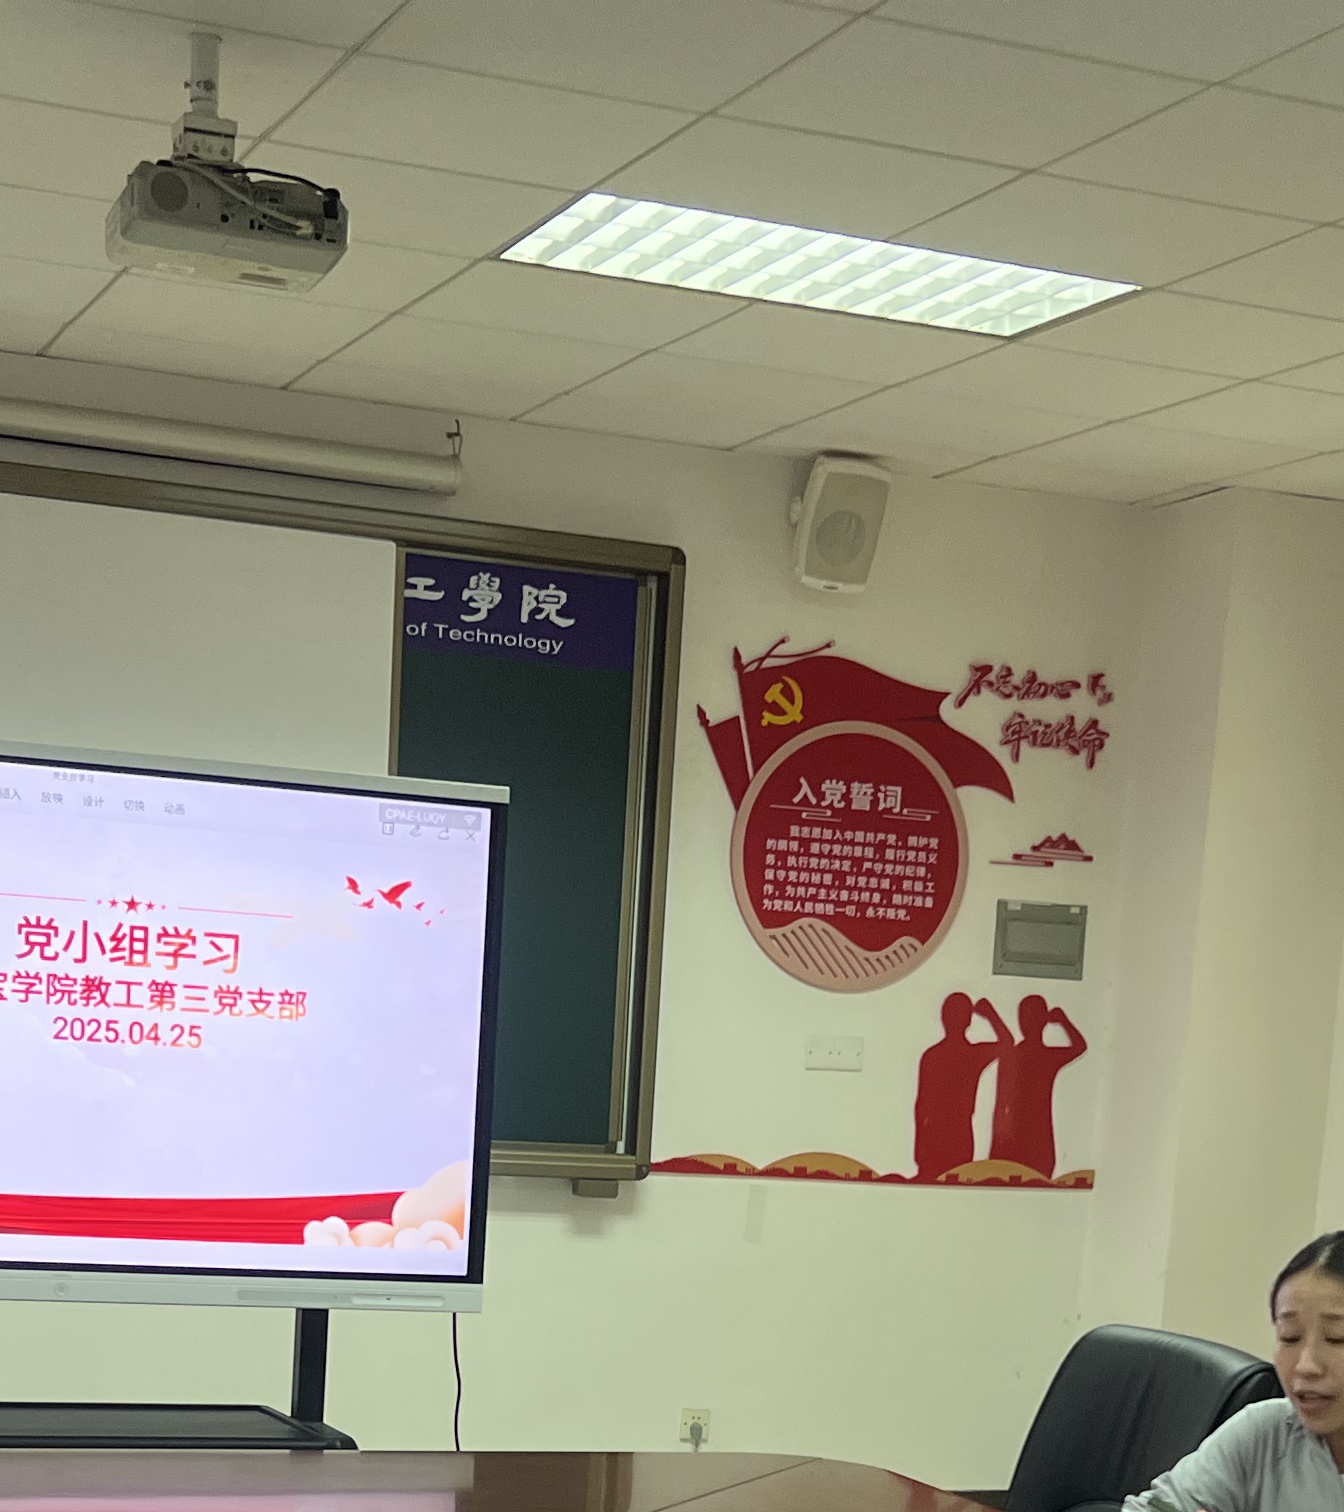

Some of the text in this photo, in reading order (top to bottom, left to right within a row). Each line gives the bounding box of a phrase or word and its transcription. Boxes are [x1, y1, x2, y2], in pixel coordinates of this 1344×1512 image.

[405, 621, 564, 656] of Technology
[999, 711, 1111, 770] 牢记使命
[40, 791, 64, 806] 放映
[82, 795, 105, 809] 设计
[791, 776, 903, 814] 入党誓词
[14, 914, 241, 974] 党小组学习
[52, 1015, 204, 1050] 2025.04.25
